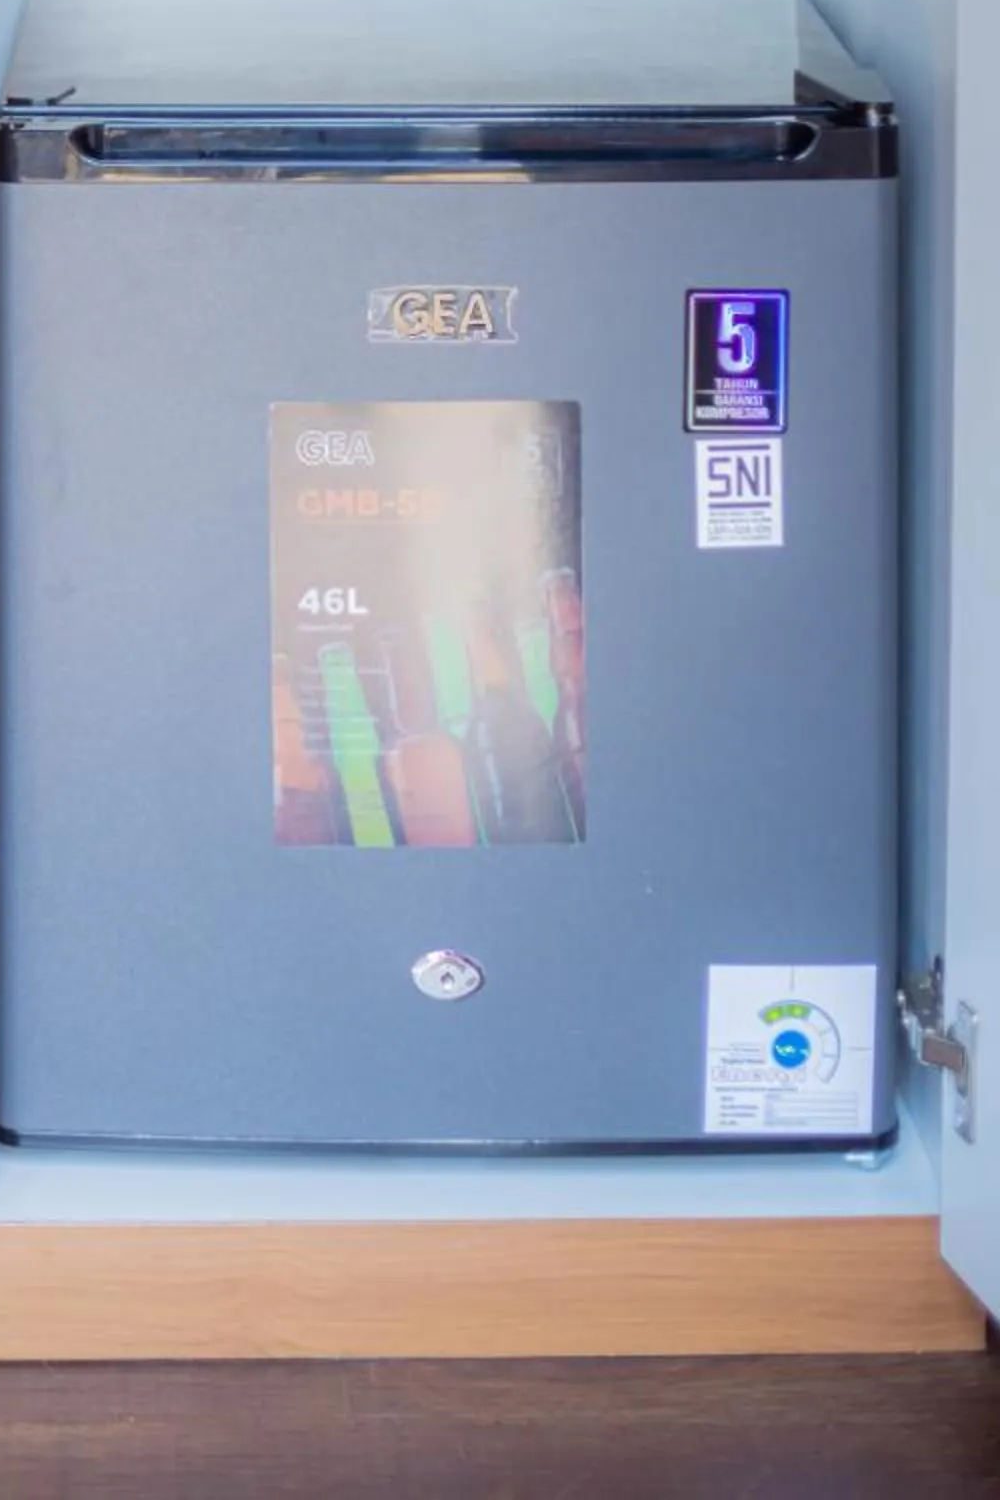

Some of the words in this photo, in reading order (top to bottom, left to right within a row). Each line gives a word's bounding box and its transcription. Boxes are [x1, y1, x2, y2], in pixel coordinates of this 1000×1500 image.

[391, 290, 496, 339] GEA
[717, 301, 756, 373] 5
[296, 430, 375, 467] GEA
[708, 455, 771, 498] SNI
[298, 587, 369, 615] 46L
